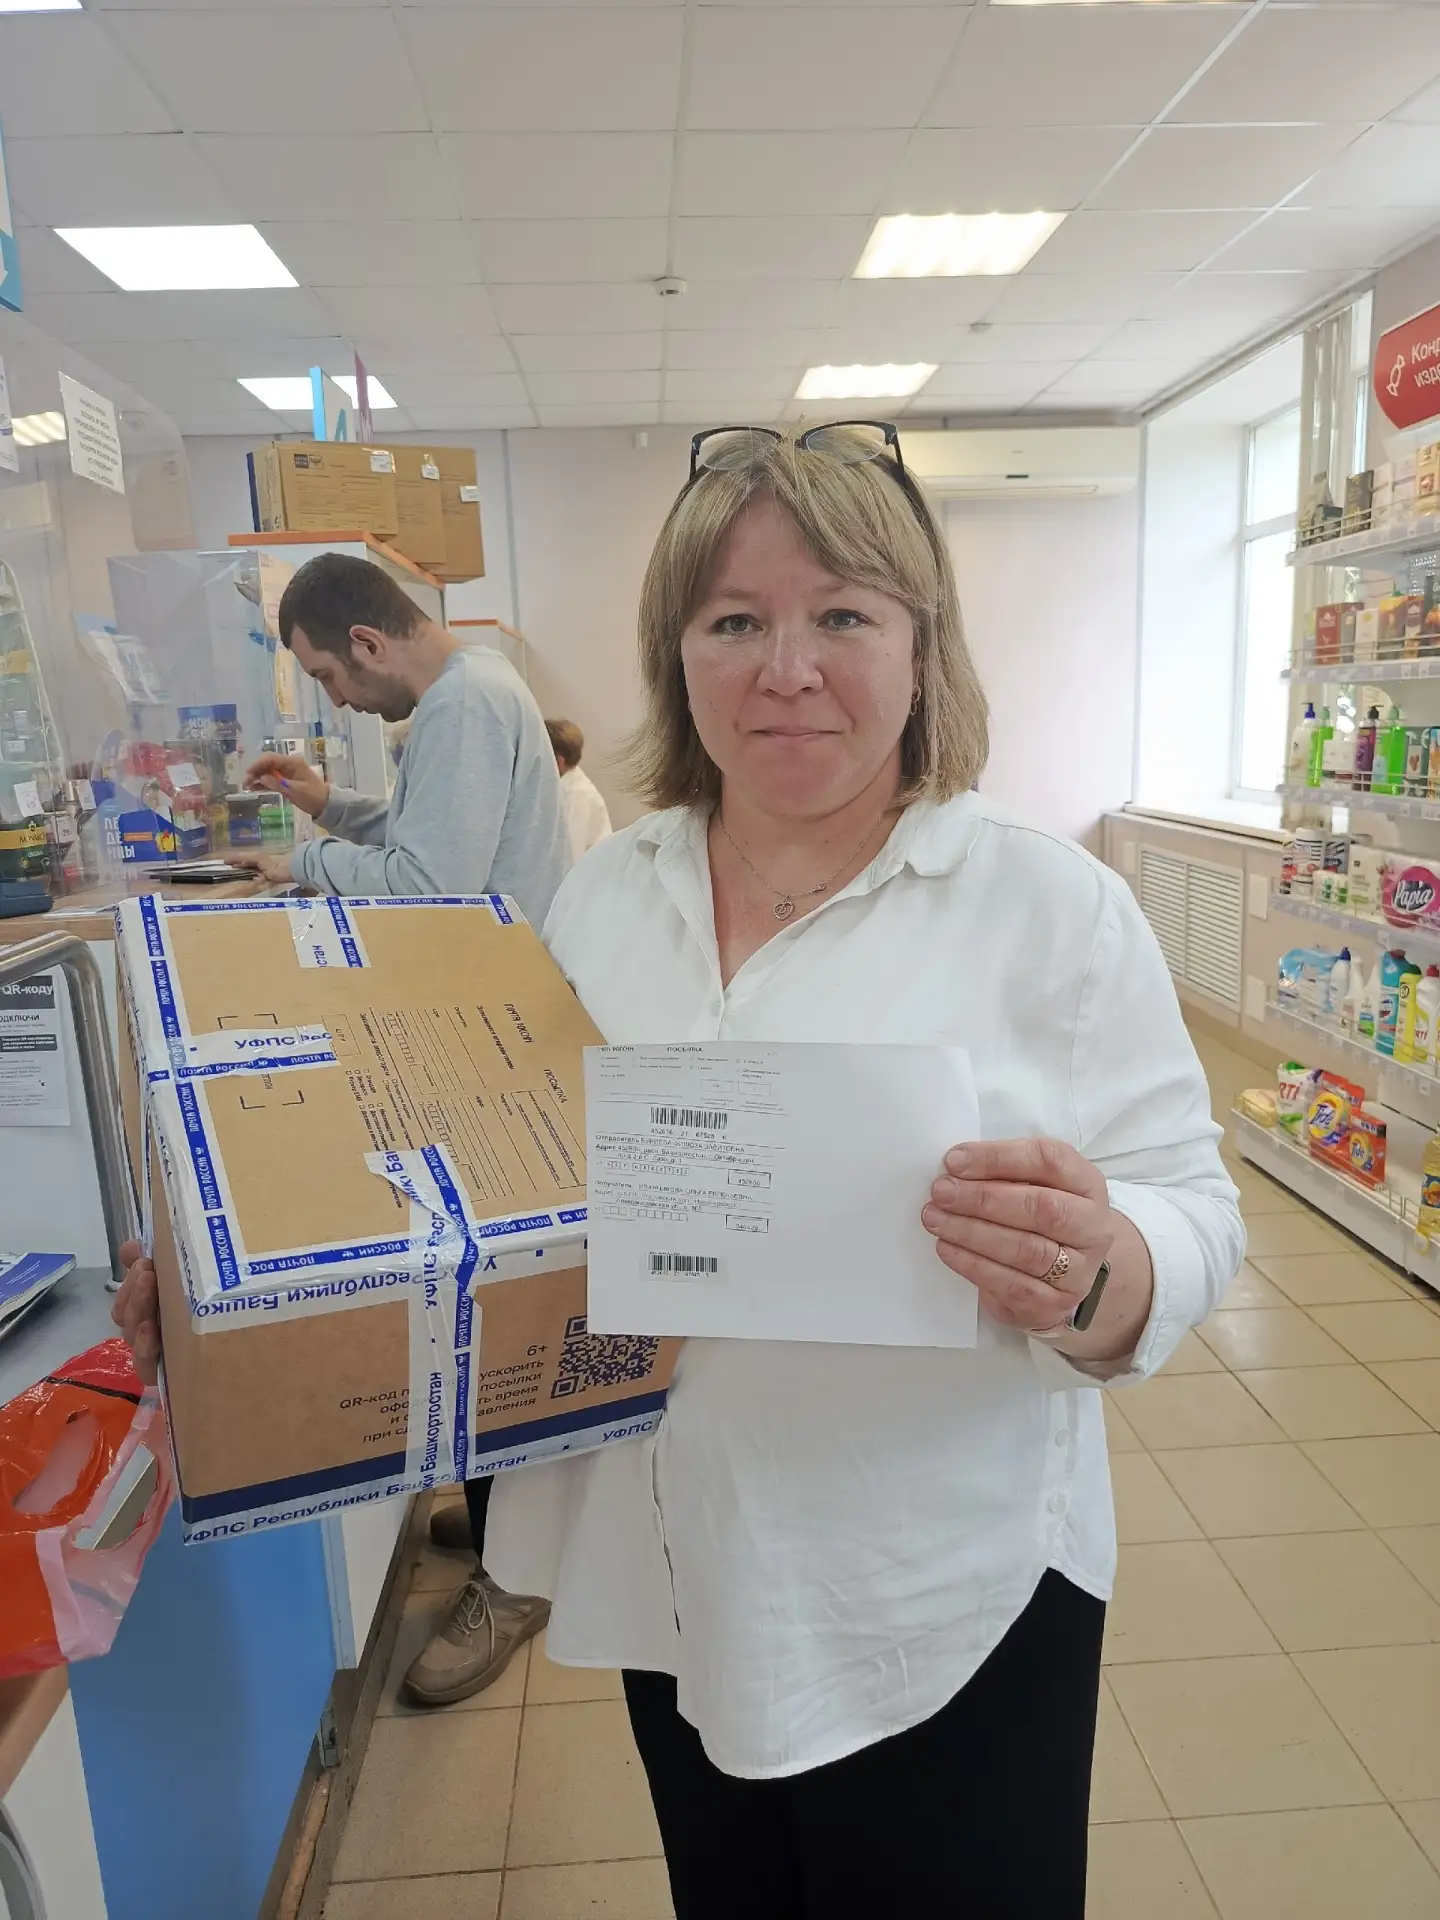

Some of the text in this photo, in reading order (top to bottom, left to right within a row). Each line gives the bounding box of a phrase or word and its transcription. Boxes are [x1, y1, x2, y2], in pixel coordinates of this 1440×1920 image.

[1397, 881, 1431, 913] Papia
[2, 984, 53, 996] QR-коду
[504, 1003, 534, 1043] ПОЧТА РОССИИ
[234, 1034, 297, 1050] УФПС
[291, 1054, 322, 1064] ПОЧТА
[543, 1069, 567, 1103] ПОСЫЛКА
[182, 1086, 200, 1133] ПОЧТА РОССИИ
[1309, 1104, 1334, 1128] Tide
[199, 1156, 218, 1210] ПОЧТА РОССИИ
[519, 1216, 551, 1229] ПОЧТА
[215, 1228, 235, 1287] ПОЧТА РОССИИ
[277, 1254, 315, 1268] ПОЧТА
[358, 1243, 401, 1257] РОССИИ
[458, 1290, 471, 1347] ПОЧТА РОССИИ
[526, 1344, 548, 1357] 6+
[339, 1389, 398, 1410] QR-код
[480, 1359, 545, 1382] ускорить
[480, 1371, 542, 1392] посылки
[390, 1415, 399, 1425] и
[495, 1384, 539, 1401] время
[363, 1429, 391, 1444] при
[420, 1371, 443, 1472] Башкортостан
[183, 1520, 246, 1545] УФПС
[253, 1490, 380, 1529] Республики
[602, 1421, 652, 1444] УФПС
